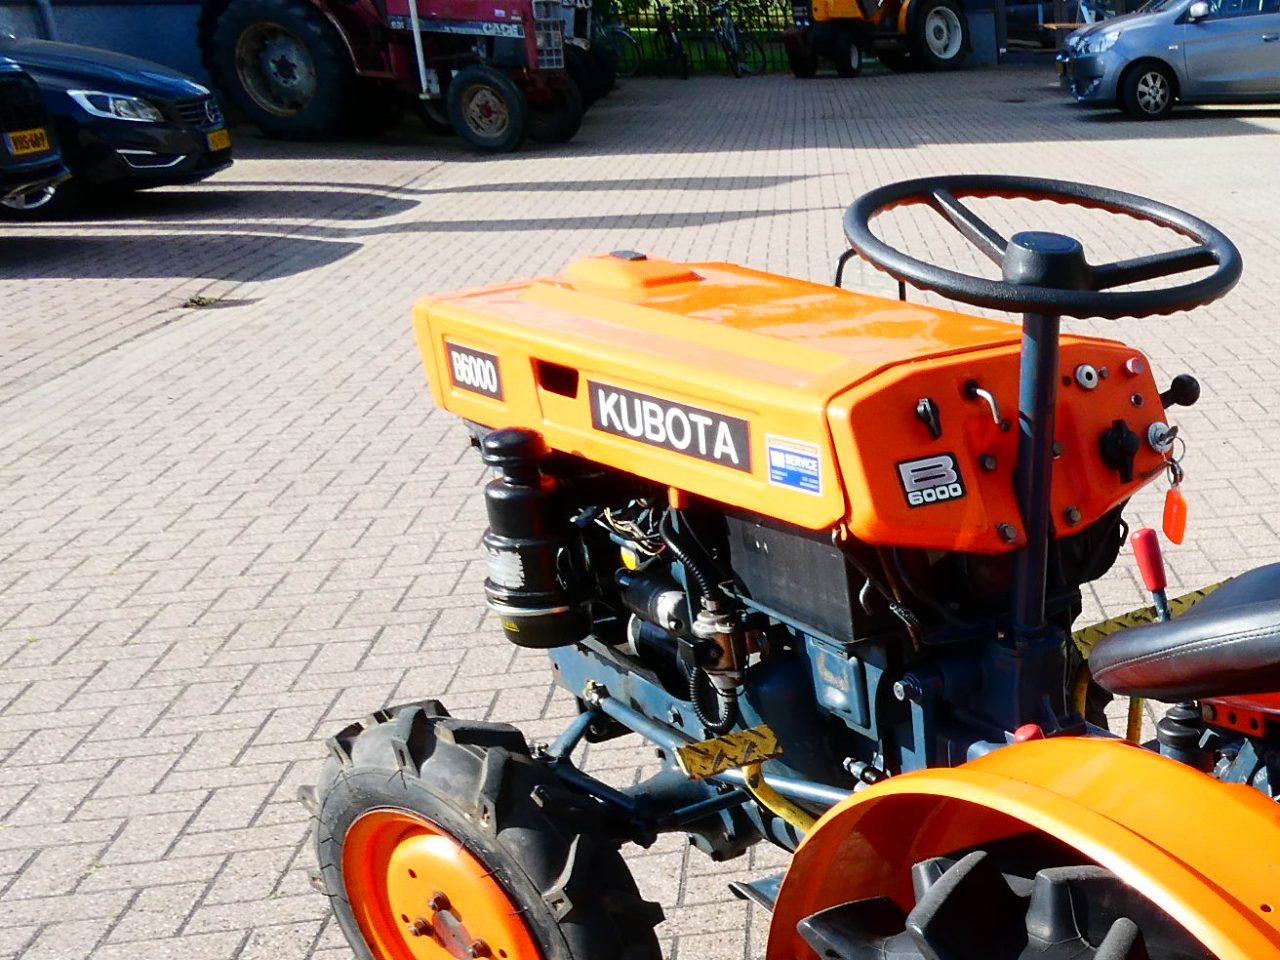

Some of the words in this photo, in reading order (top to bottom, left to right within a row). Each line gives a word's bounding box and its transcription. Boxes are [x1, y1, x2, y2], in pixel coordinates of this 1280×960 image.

[451, 350, 498, 393] B6000
[598, 388, 739, 464] KUBOTA
[785, 453, 818, 472] SERVICE
[900, 455, 958, 493] B
[907, 483, 963, 506] 6000
